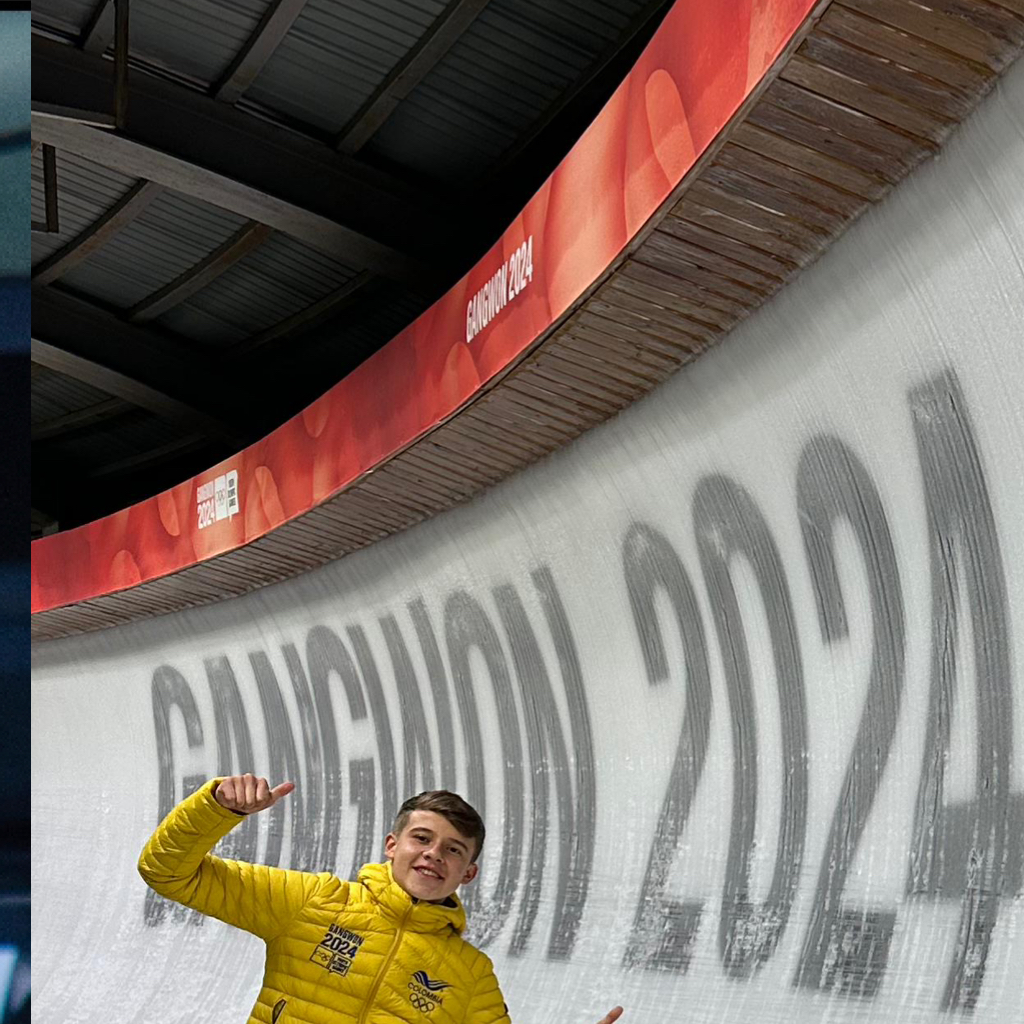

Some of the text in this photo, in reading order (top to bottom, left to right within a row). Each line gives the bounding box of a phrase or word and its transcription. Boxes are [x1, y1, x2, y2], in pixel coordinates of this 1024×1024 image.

[466, 235, 533, 343] GANGWON 2024
[197, 498, 216, 530] 2024
[143, 367, 1024, 1016] GANGWON 2024
[321, 933, 358, 959] 2024
[328, 923, 365, 947] GANGWON
[407, 982, 444, 1005] COLOMBIA
